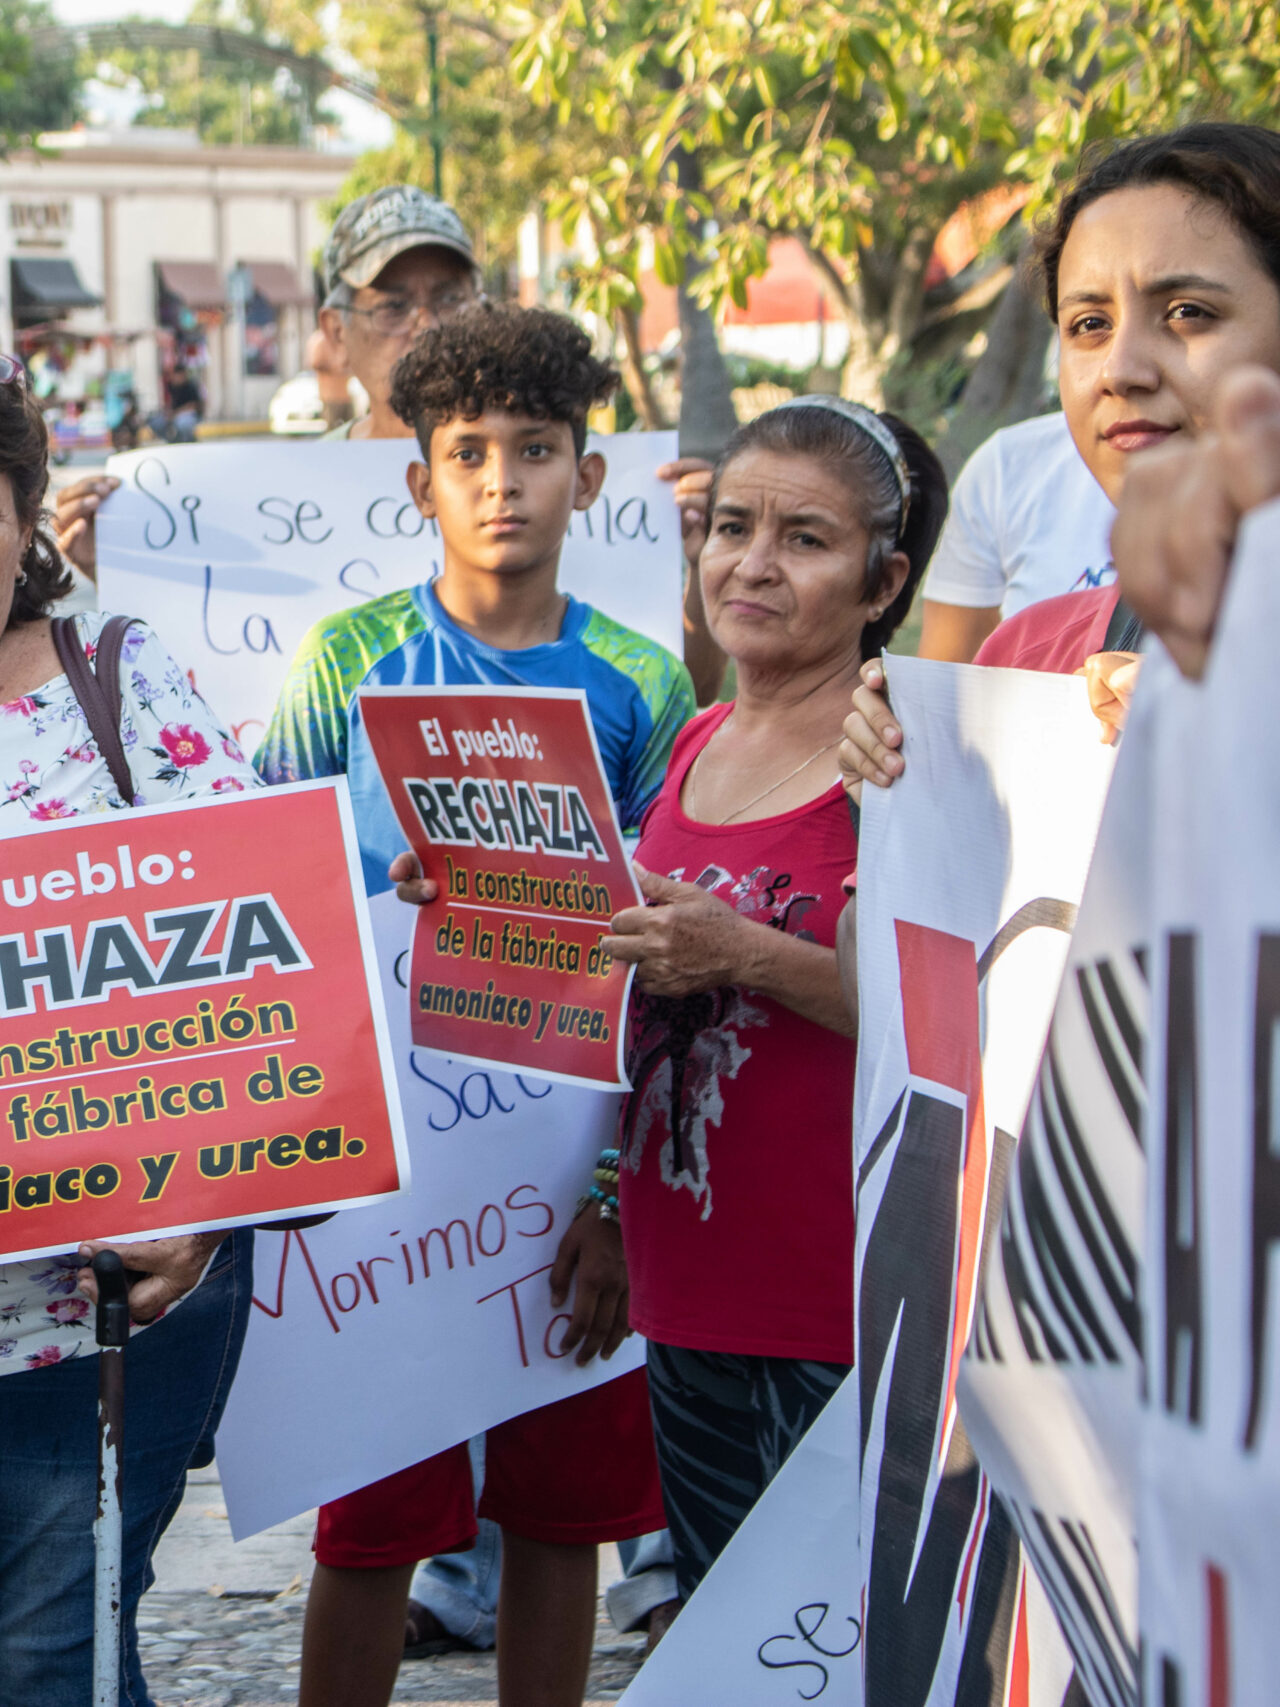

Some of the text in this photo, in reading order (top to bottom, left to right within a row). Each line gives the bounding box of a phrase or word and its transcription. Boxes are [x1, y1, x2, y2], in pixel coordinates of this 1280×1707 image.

[133, 456, 201, 551] Si
[257, 496, 335, 546] se
[418, 717, 545, 767] El pueblo:
[402, 776, 611, 864] RECHAZA
[446, 854, 612, 916] la construcción
[435, 913, 613, 980] de la fábrica de
[419, 980, 611, 1044] amoniaco y urea.
[8, 1074, 229, 1142] fábrica
[246, 1053, 326, 1104] de
[137, 1151, 179, 1205] y
[196, 1122, 367, 1182] urea.
